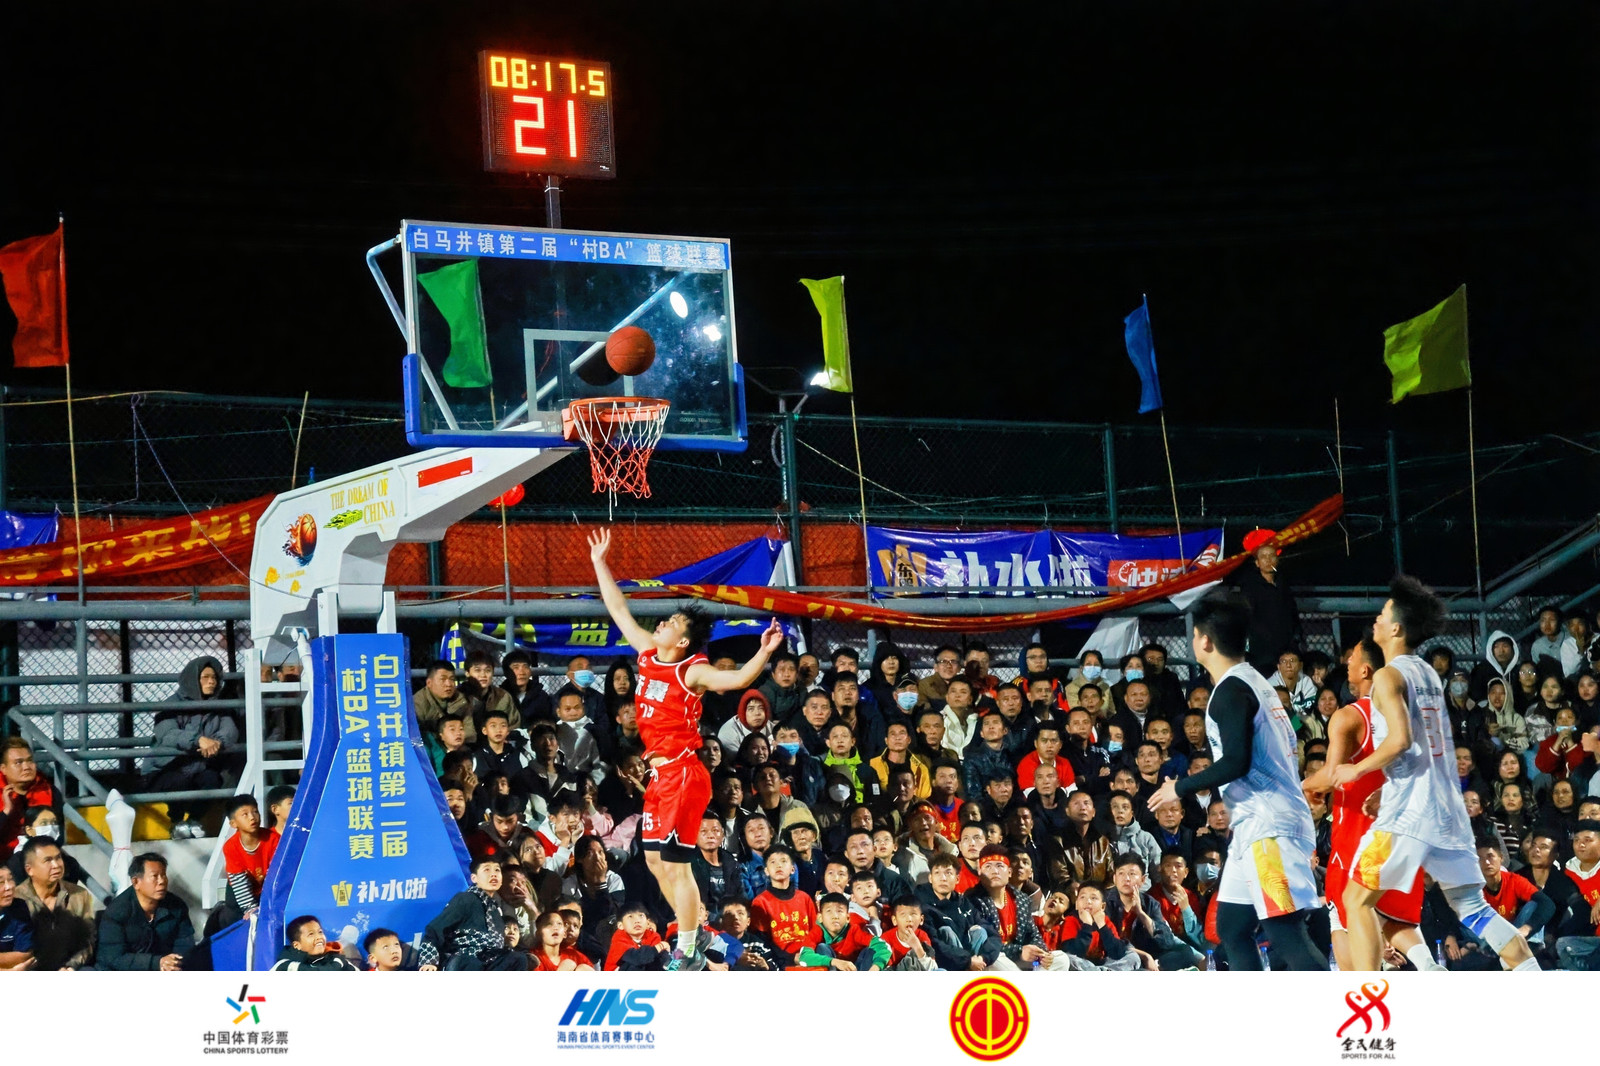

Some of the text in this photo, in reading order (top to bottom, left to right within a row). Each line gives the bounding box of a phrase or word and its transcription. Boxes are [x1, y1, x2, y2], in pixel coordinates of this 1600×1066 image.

[490, 56, 605, 96] 08:17.5
[512, 95, 578, 158] 21
[413, 229, 557, 258] 白马井镇第二届
[331, 478, 388, 510] THE DREAM OF
[364, 501, 394, 524] CHINA
[373, 653, 408, 858] 白马井镇第二届
[356, 877, 428, 903] 补水啦
